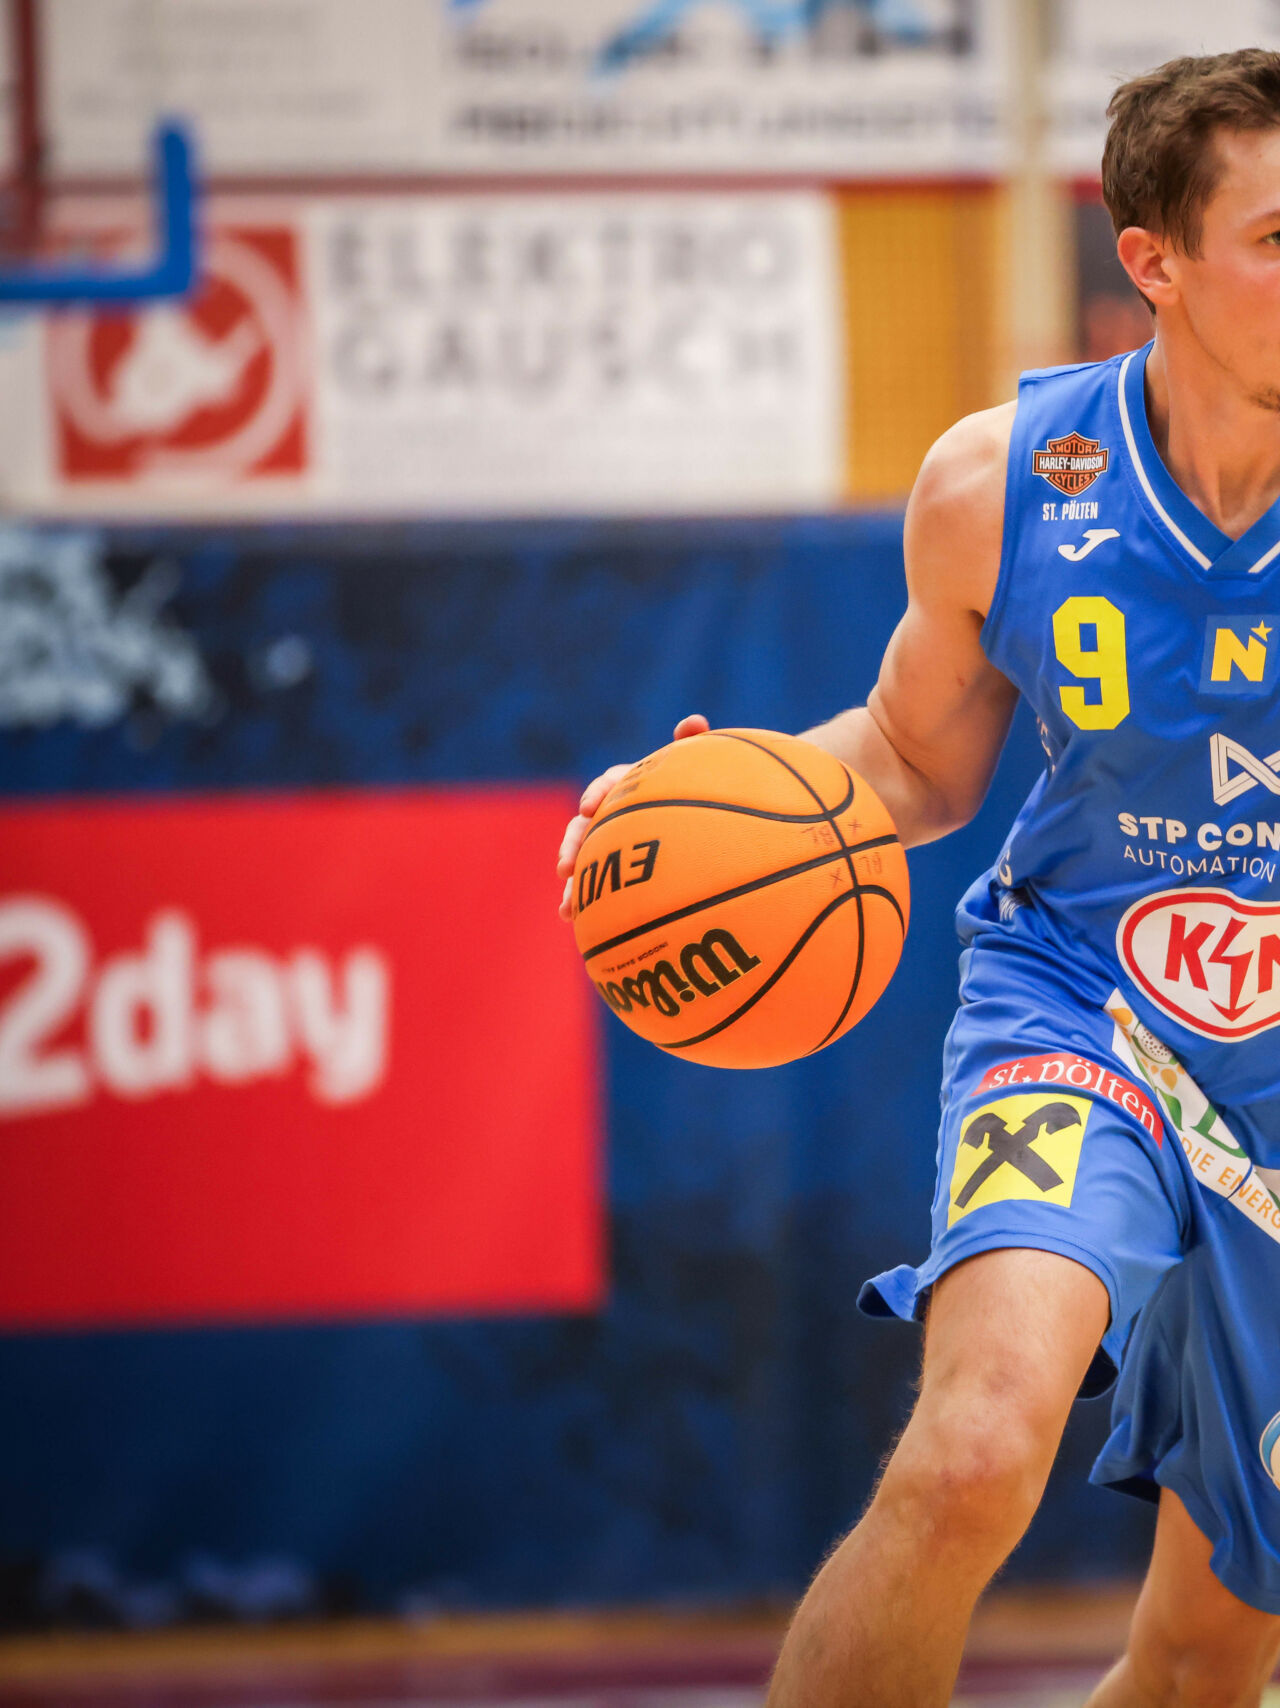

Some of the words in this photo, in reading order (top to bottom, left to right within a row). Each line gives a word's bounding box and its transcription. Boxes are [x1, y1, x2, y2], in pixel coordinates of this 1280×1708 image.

[1055, 439, 1093, 454] MOTOR
[1039, 454, 1104, 470] HARLEY-DAVIDSON
[1054, 472, 1091, 489] CYCLES
[1042, 502, 1058, 521] ST.
[1061, 500, 1099, 521] PÖLTEN
[1052, 595, 1131, 731] 9
[1117, 811, 1188, 844] STP
[578, 838, 661, 914] EVO
[1123, 844, 1277, 883] AUTOMATION
